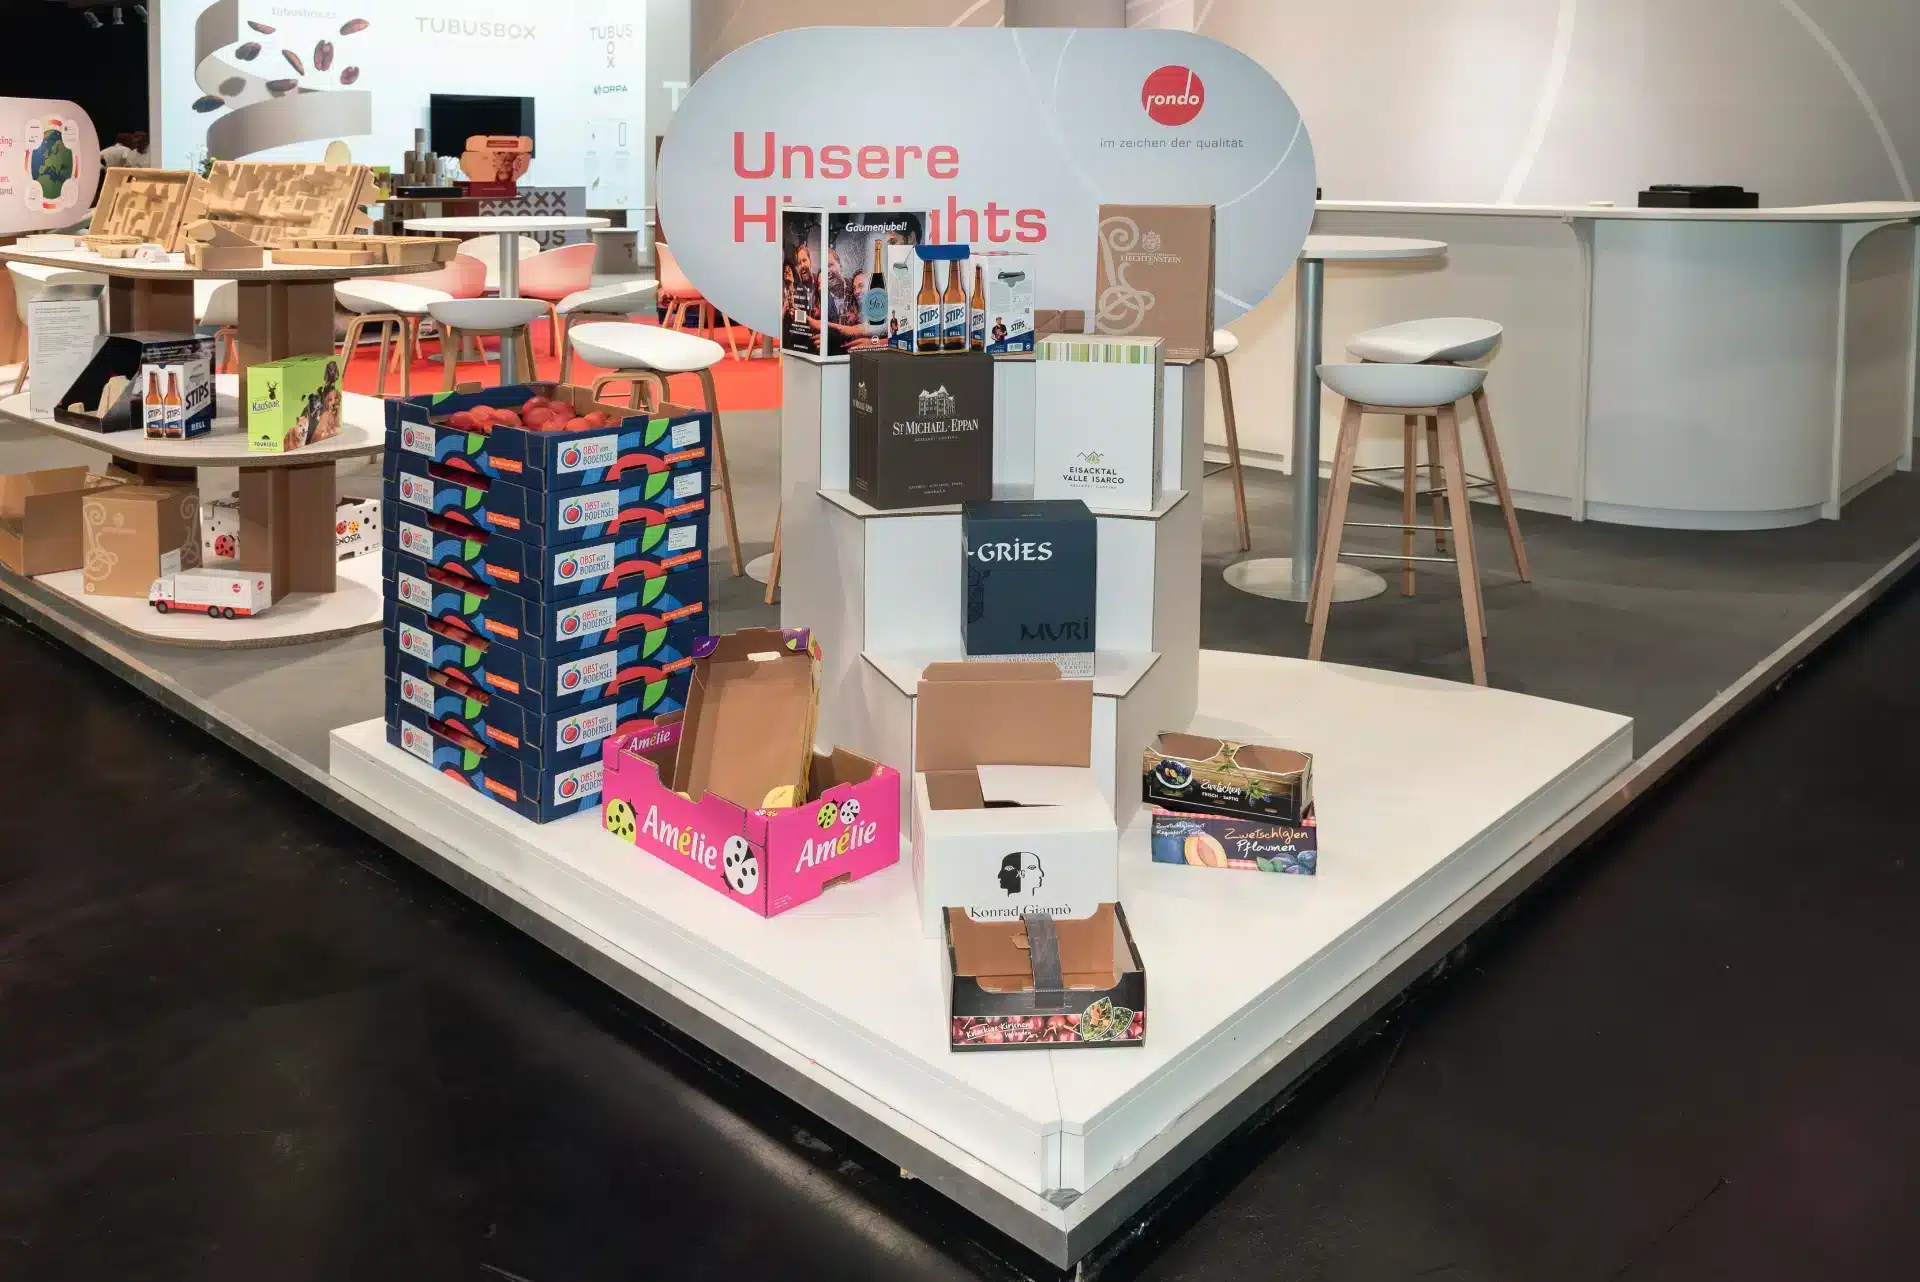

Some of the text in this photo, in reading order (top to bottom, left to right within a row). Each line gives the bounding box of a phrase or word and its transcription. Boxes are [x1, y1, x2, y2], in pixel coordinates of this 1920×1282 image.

[415, 16, 537, 40] TUBUSBOX
[590, 24, 633, 40] TUBUS
[1100, 138, 1244, 151] im zeichen der qualität
[733, 131, 960, 180] Unsere
[845, 221, 908, 233] Gaumenjubel!
[1120, 255, 1182, 264] LIECHTENSTEIN
[919, 308, 939, 325] STIPS
[945, 307, 965, 323] STIPS
[972, 313, 984, 326] STIPS
[1011, 320, 1025, 331] STIPS
[185, 381, 209, 411] STIPS
[583, 444, 599, 455] OBST
[583, 452, 613, 465] BODENSEE
[1069, 467, 1117, 475] EISACKTAL
[584, 501, 600, 511] OBST
[584, 508, 614, 521] BODENSEE
[580, 554, 596, 565] OBST
[580, 561, 610, 575] BODENSEE
[582, 609, 598, 620] OBST
[582, 615, 612, 630] BODENSEE
[583, 663, 598, 675] OBST
[583, 669, 613, 684] BODENSEE
[582, 717, 599, 729] OBST
[583, 722, 612, 738] BODENSEE
[629, 729, 671, 751] Amélie
[581, 771, 596, 783] OBST
[642, 805, 718, 870] Amélie
[795, 819, 877, 873] Amélie
[1236, 839, 1297, 858] Pflaumen
[971, 905, 1019, 917] Konrad
